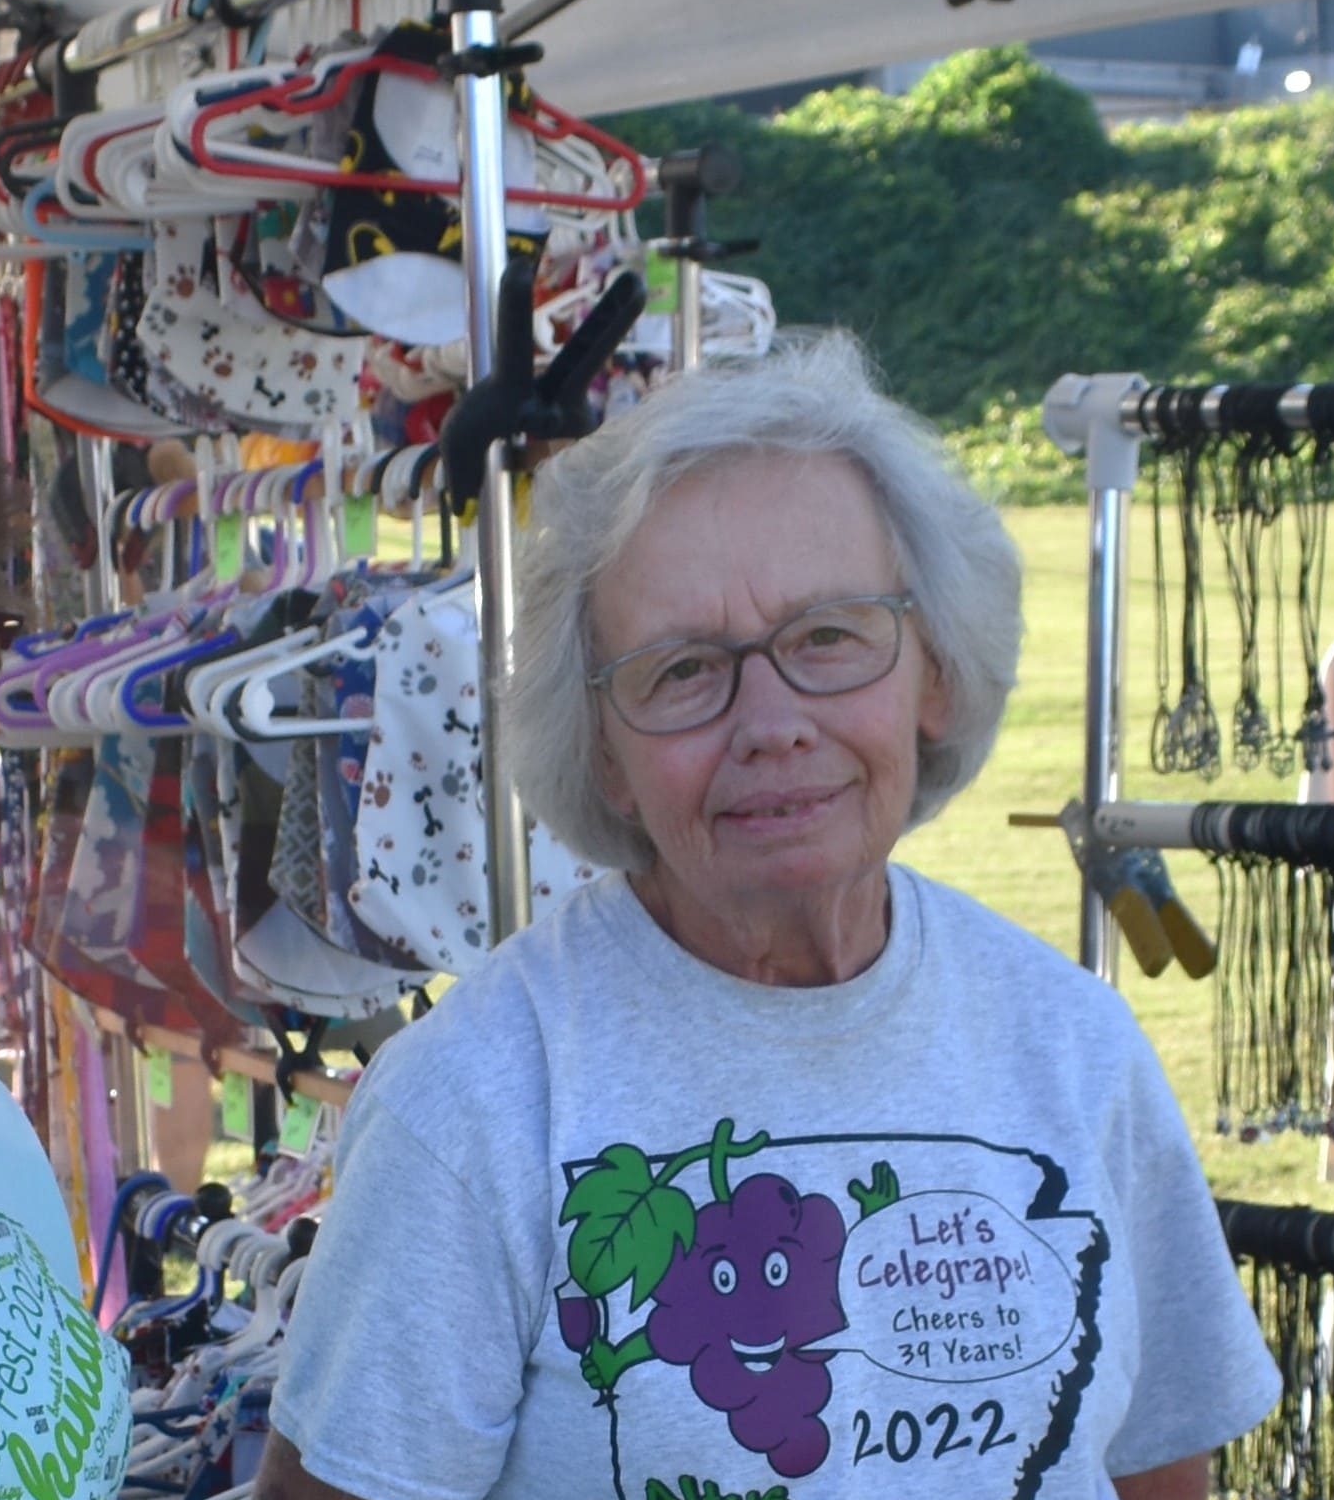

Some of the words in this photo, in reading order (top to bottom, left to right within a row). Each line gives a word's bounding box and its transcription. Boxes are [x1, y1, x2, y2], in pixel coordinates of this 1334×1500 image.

[910, 1205, 996, 1247] Let's
[857, 1248, 1034, 1299] Celegrape!
[892, 1306, 985, 1334] Cheers
[997, 1306, 1020, 1328] to
[897, 1340, 931, 1368] 39
[942, 1336, 1024, 1366] Years!
[851, 1400, 1017, 1467] 2022
